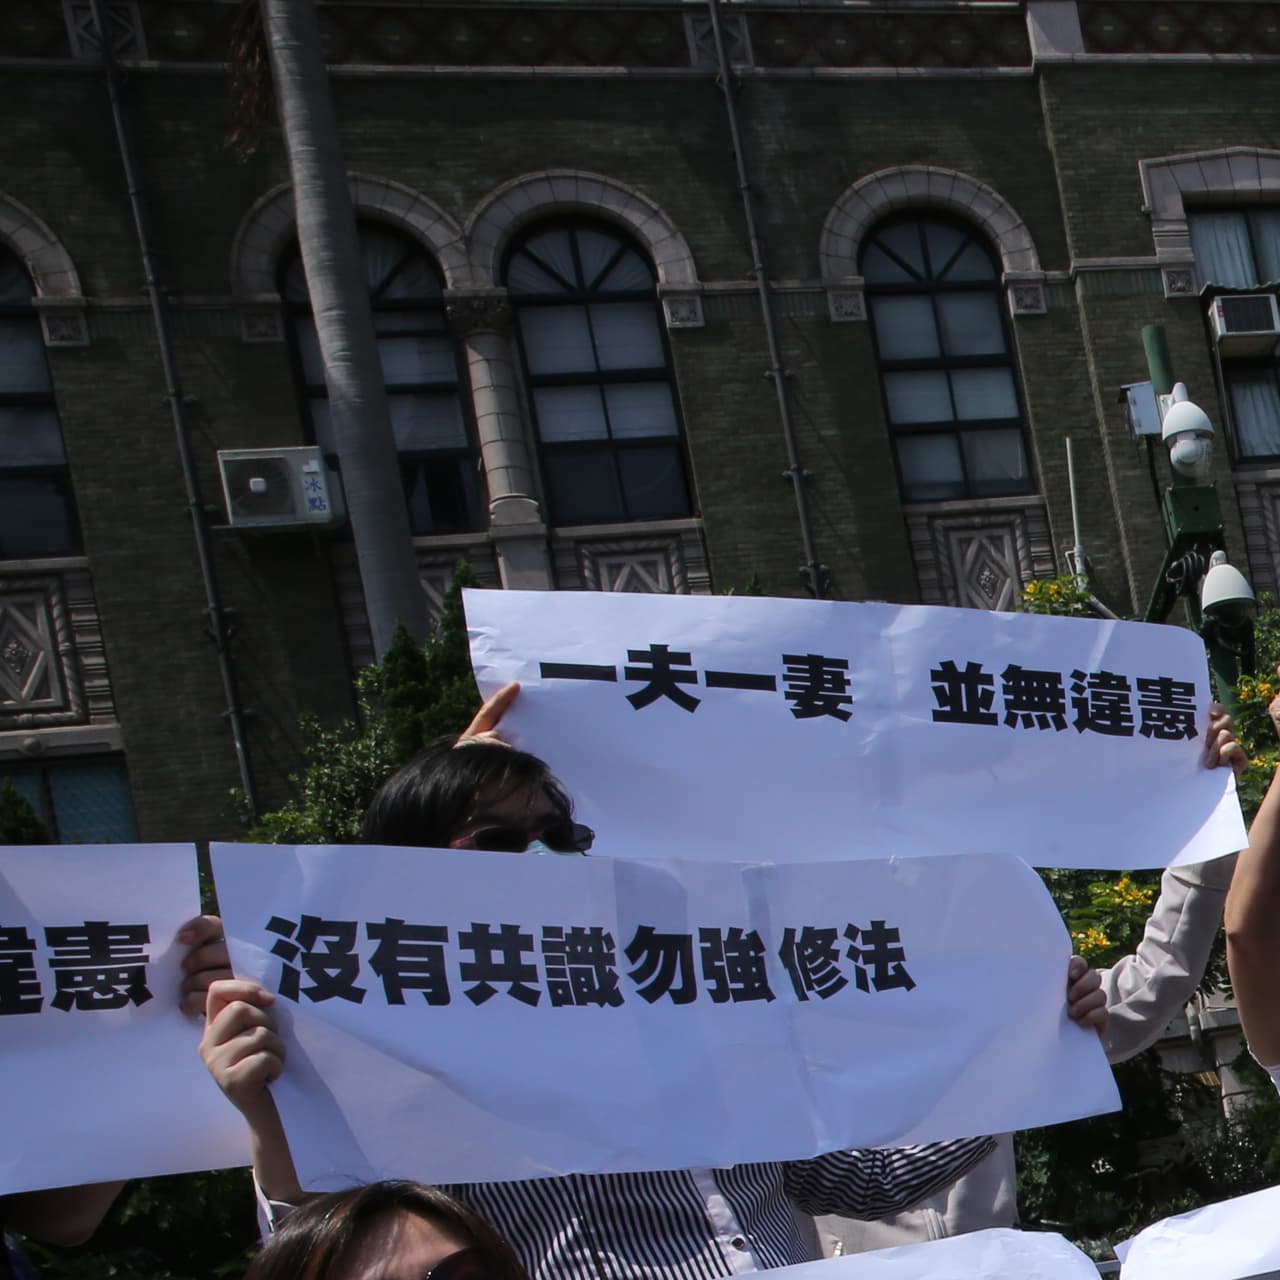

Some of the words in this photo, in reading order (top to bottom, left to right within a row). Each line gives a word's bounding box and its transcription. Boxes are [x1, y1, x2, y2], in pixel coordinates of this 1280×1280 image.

[540, 644, 854, 723] 一夫一妻
[930, 660, 1199, 740] 並無違憲
[265, 915, 917, 1008] 沒有共識勿強修法
